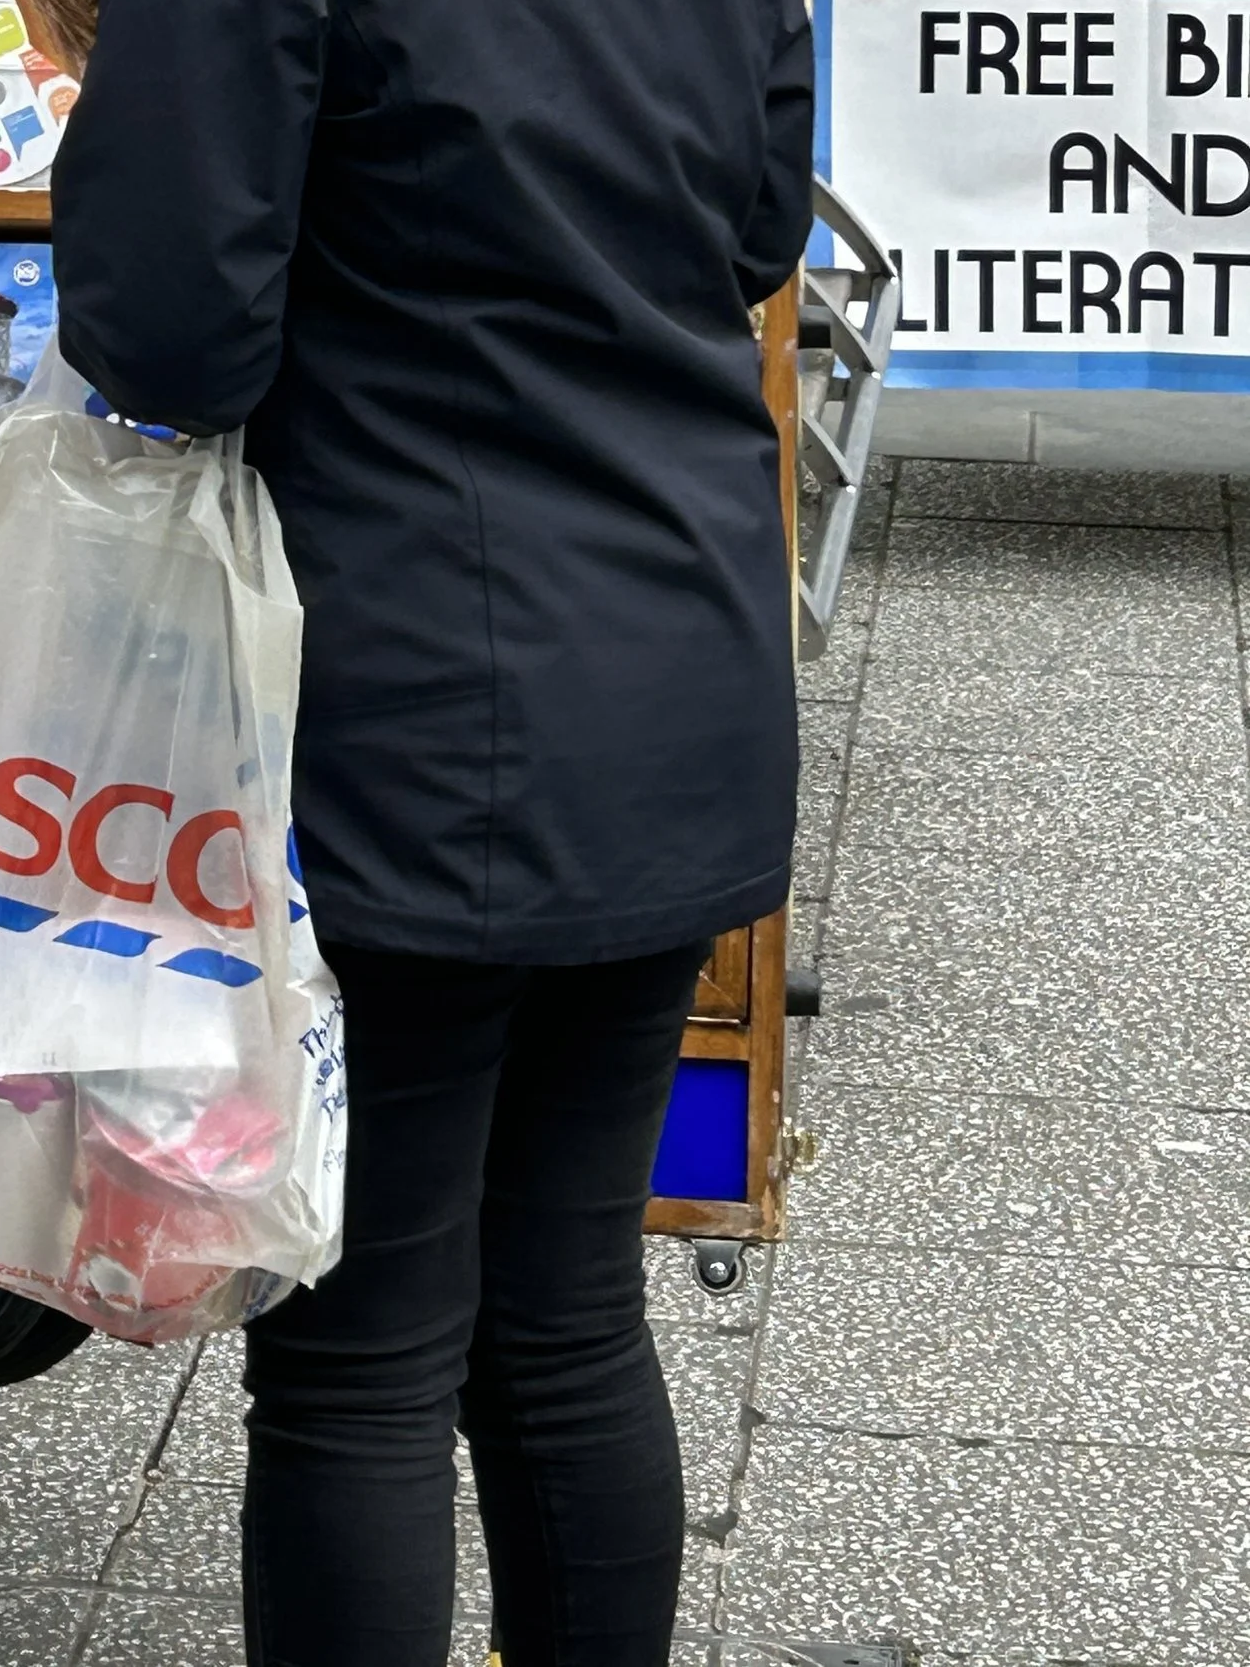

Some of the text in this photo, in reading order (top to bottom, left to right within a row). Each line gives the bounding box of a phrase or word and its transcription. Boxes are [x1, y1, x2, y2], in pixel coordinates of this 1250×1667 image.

[919, 11, 1250, 98] FREE BI
[1049, 132, 1250, 216] AND
